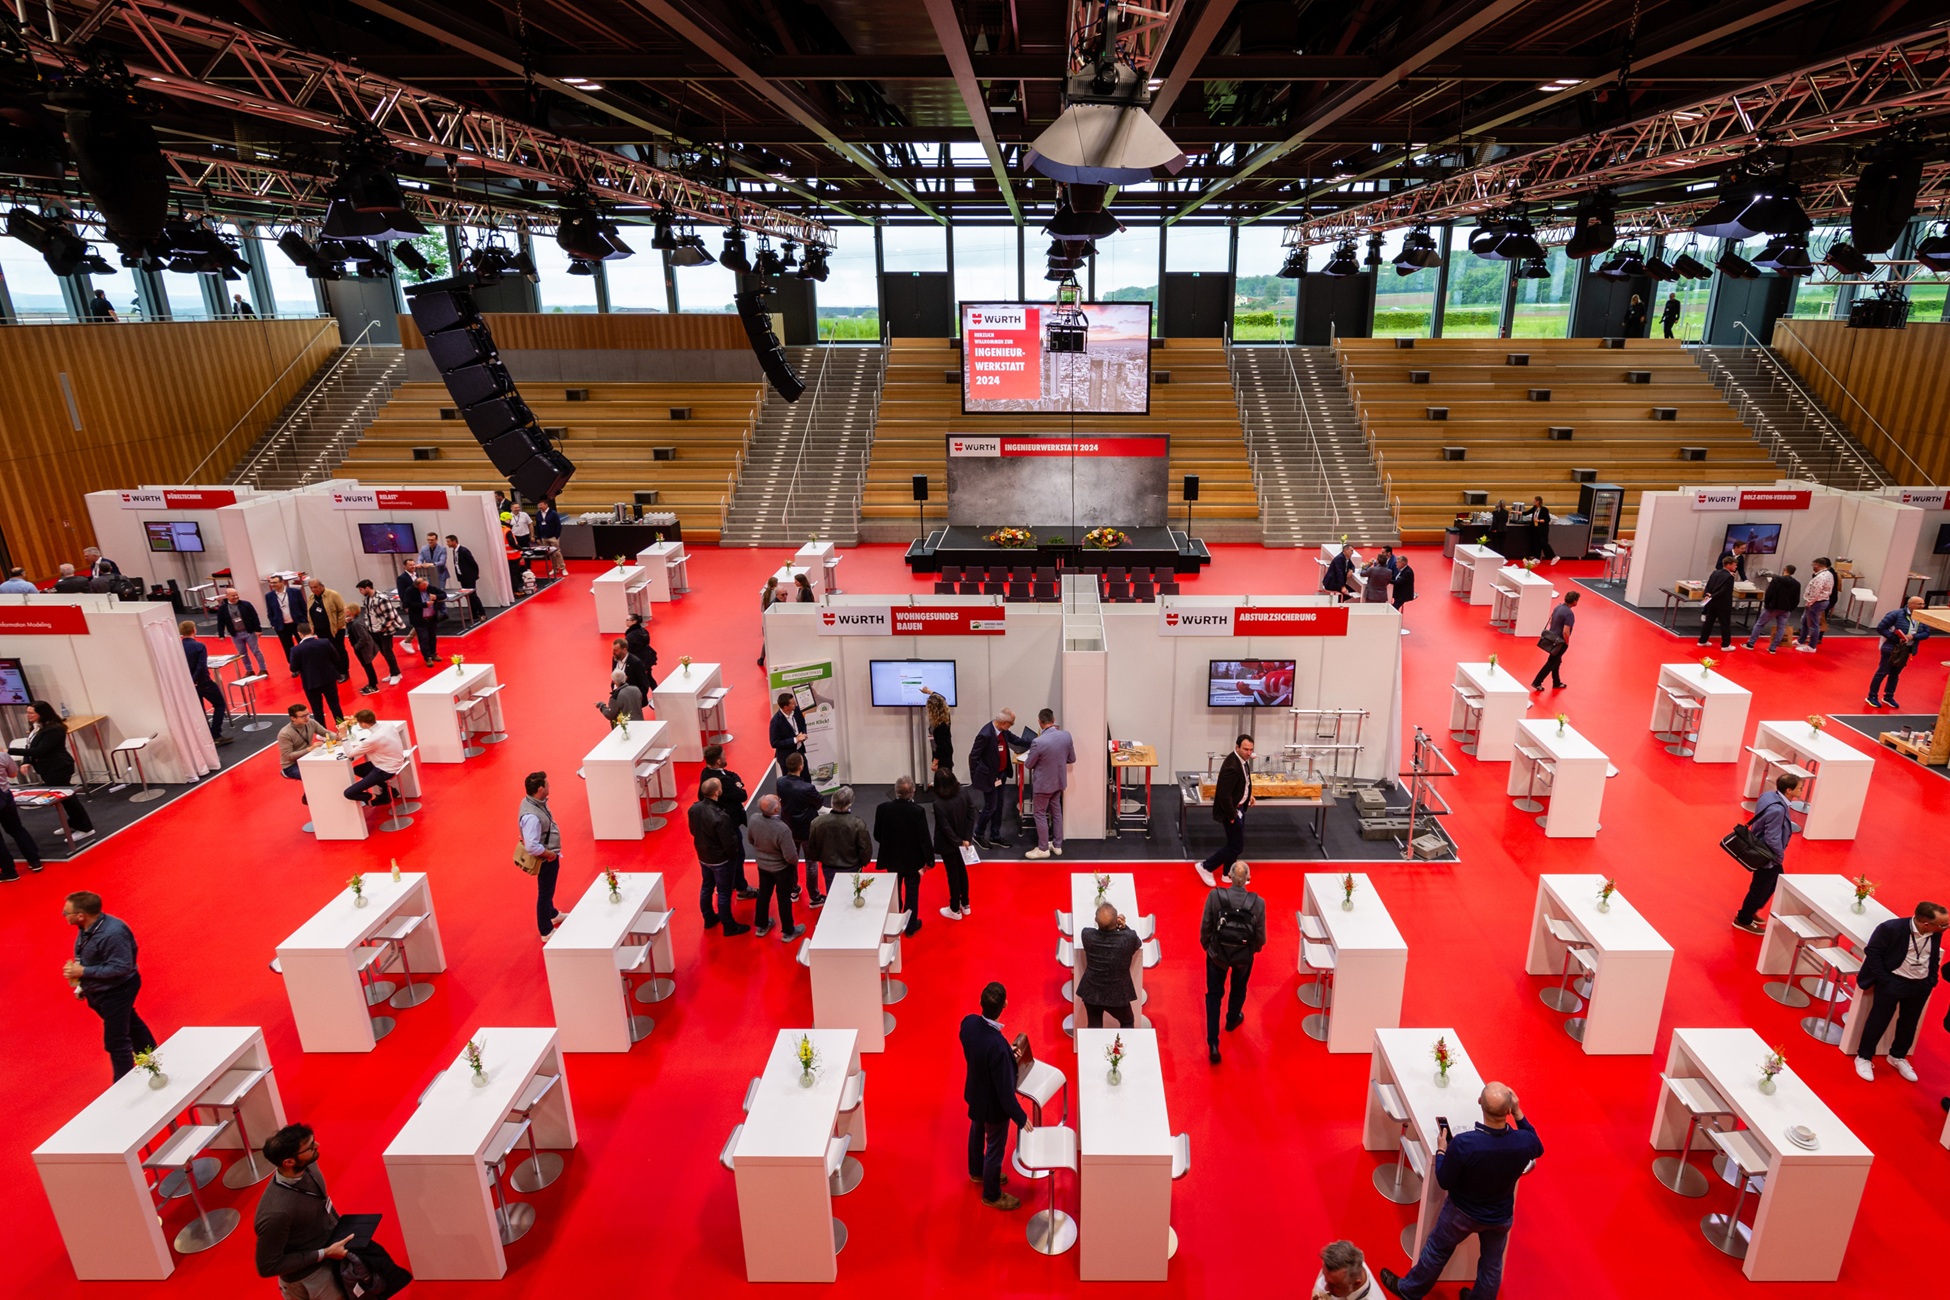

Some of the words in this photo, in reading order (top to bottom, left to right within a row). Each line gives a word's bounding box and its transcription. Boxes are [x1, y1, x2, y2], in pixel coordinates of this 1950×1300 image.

[984, 315, 1021, 324] WÜRTH
[974, 347, 1026, 357] INGENIEUR-
[975, 361, 1025, 371] WERKSTATT
[975, 375, 1000, 385] 2024
[964, 443, 996, 451] WÜRTH
[1004, 443, 1079, 452] INGENIEURWERKSTATT
[1079, 443, 1099, 451] 2024
[838, 615, 885, 625] WÜRTH
[896, 612, 959, 621] WOHNGESUNDES
[1181, 615, 1228, 625] WÜRTH
[1239, 613, 1317, 622] ABSTURZSICHERUNG
[896, 622, 923, 631] BAUEN
